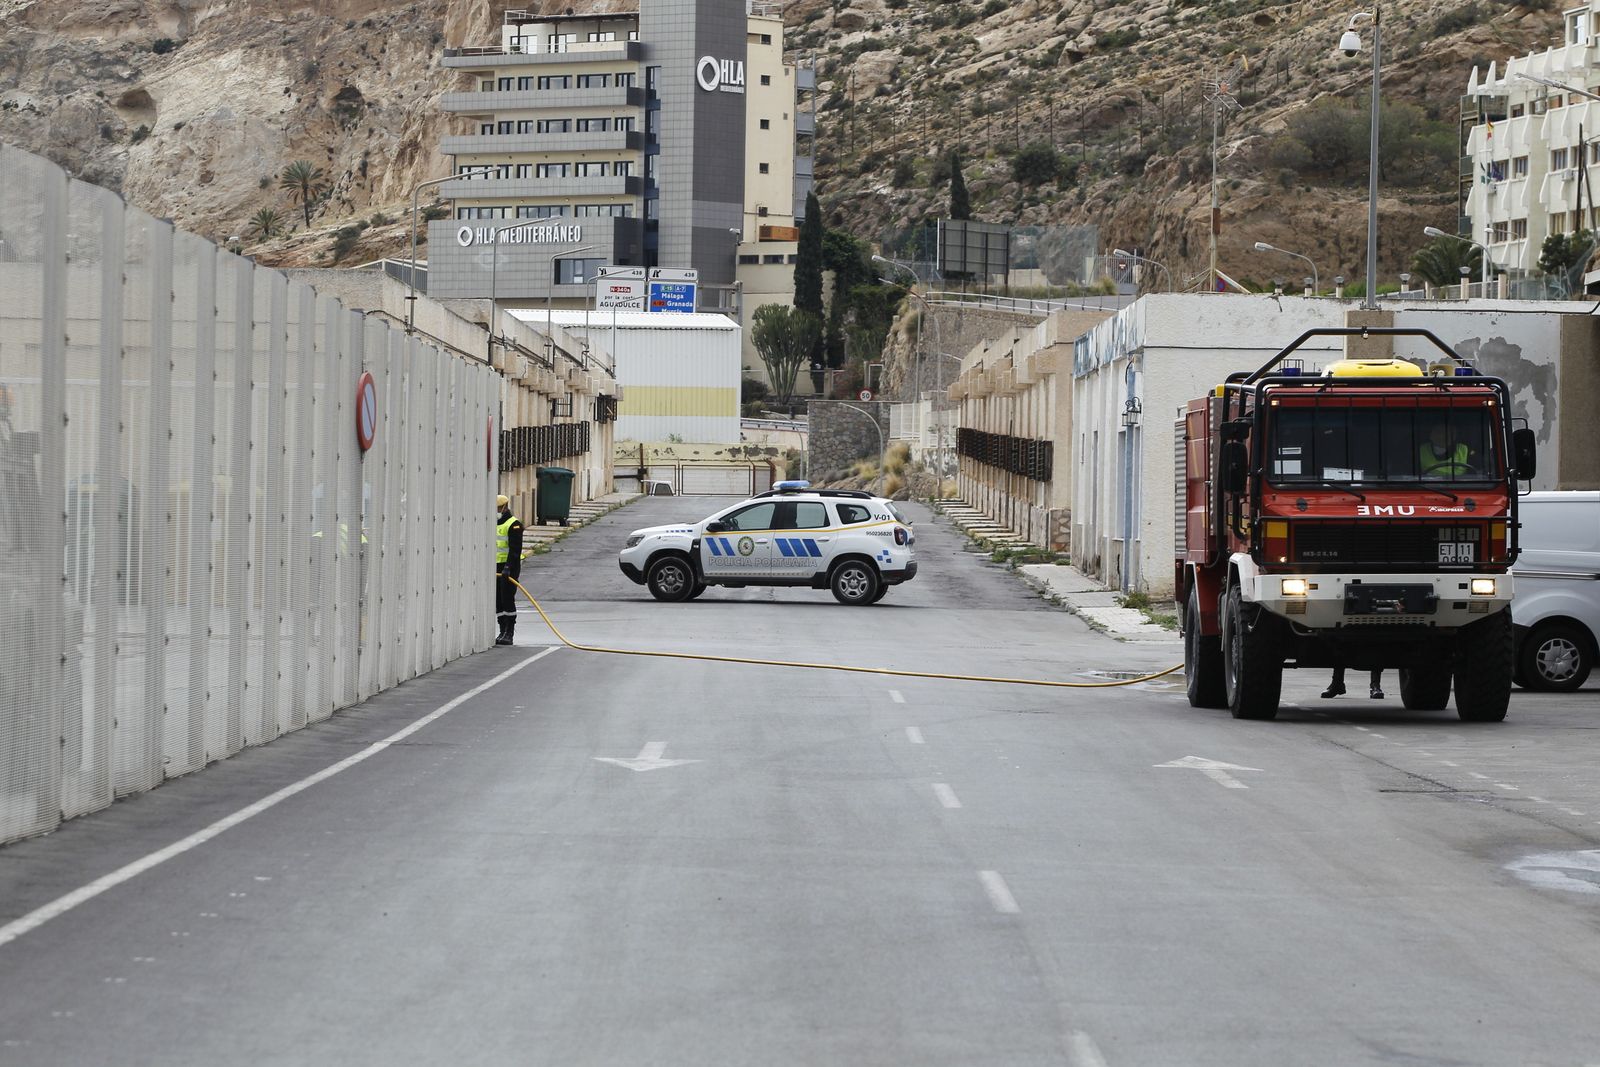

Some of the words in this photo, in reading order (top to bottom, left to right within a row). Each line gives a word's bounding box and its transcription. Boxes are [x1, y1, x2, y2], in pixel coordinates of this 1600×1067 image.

[720, 59, 745, 85] HLA
[476, 227, 496, 244] HLA
[500, 222, 582, 243] MEDITERRÁNEO
[1440, 544, 1453, 556] ET
[1460, 544, 1471, 556] 11
[754, 558, 818, 568] PORTUARIA
